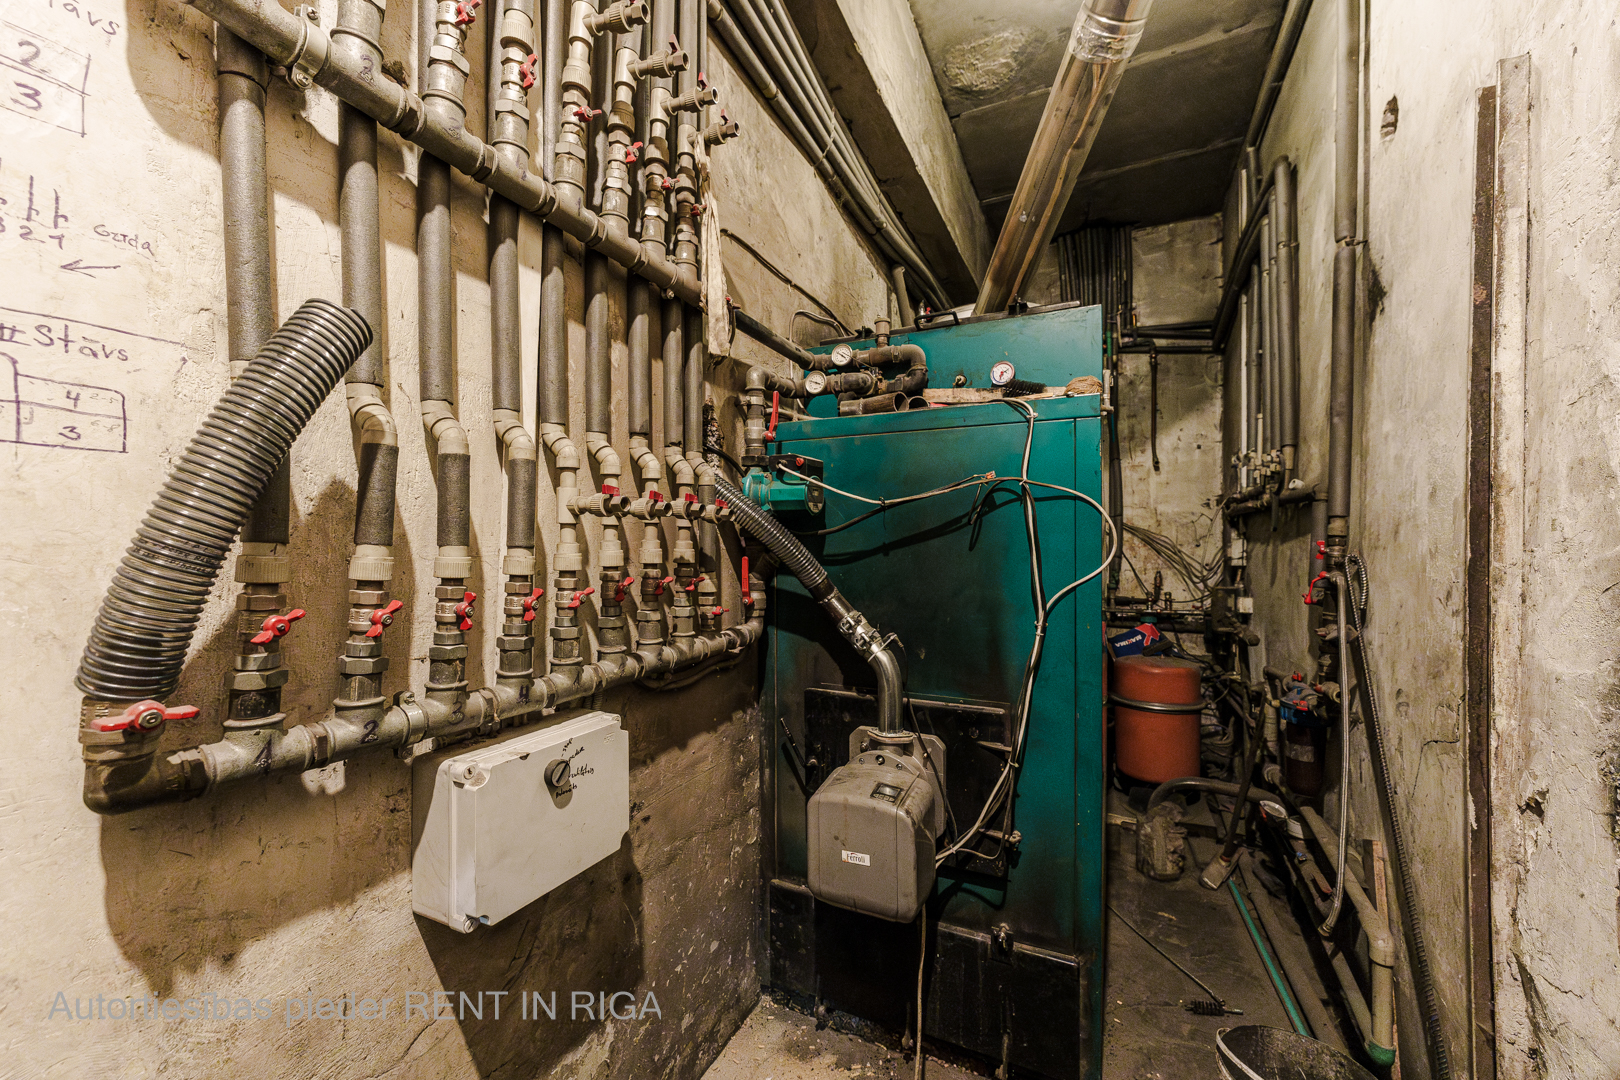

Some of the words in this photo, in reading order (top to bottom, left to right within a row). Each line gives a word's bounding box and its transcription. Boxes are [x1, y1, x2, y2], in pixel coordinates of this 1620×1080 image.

[18, 39, 51, 75] 2
[10, 81, 42, 111] 3
[19, 225, 46, 244] 2
[33, 323, 129, 361] Stāvs
[66, 389, 81, 409] 4
[58, 425, 82, 441] 3
[359, 719, 380, 745] 2
